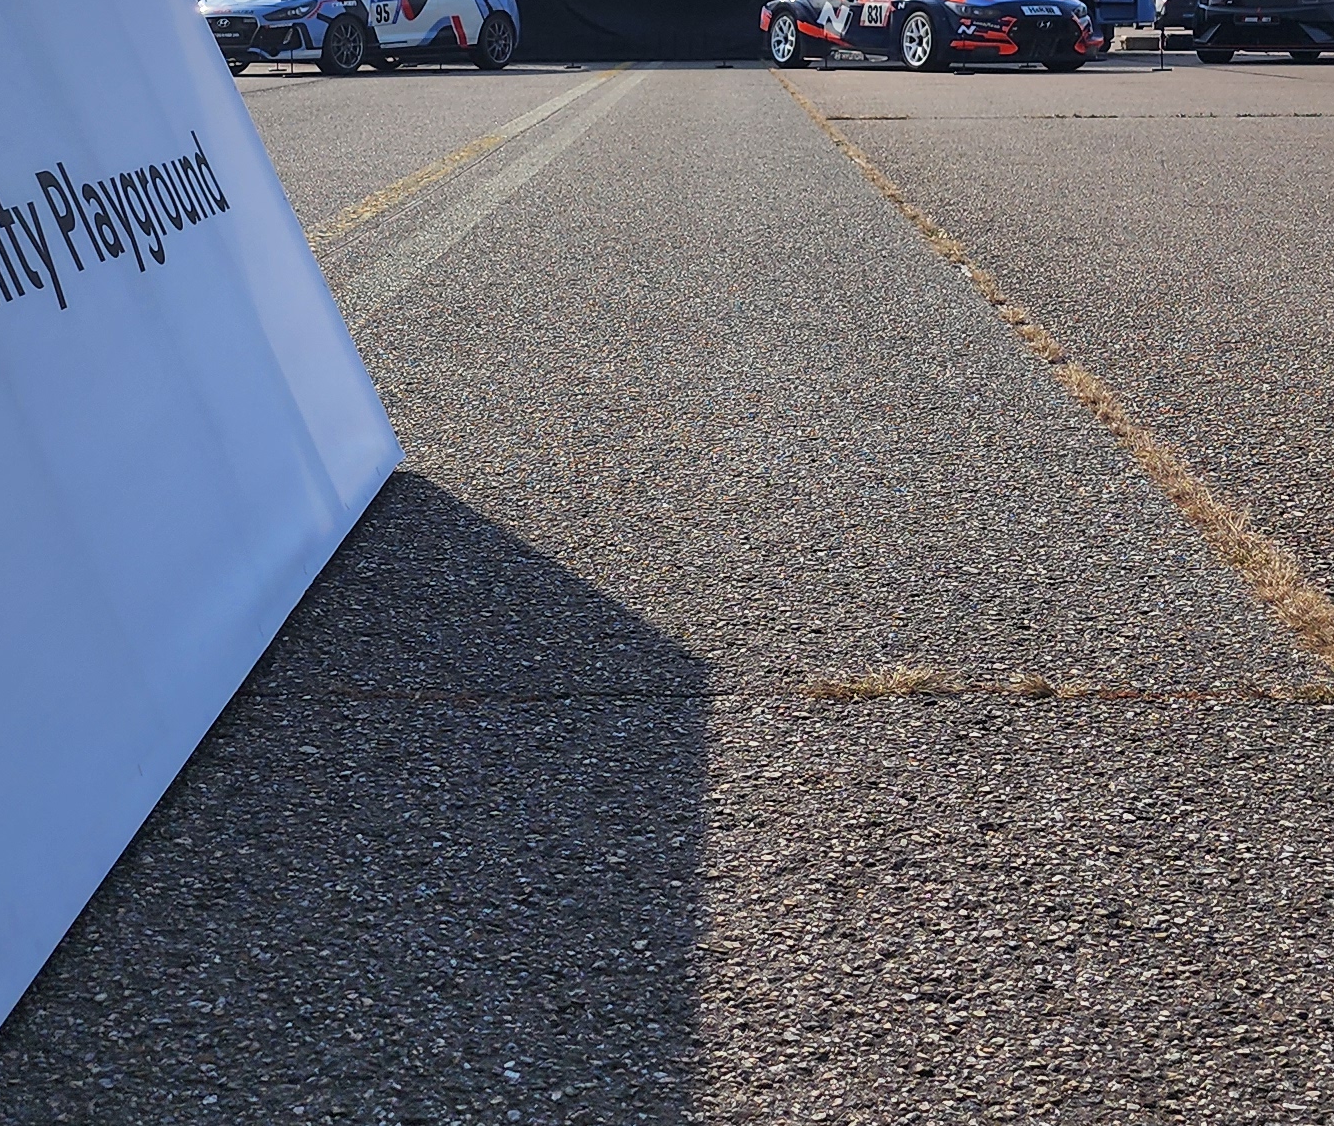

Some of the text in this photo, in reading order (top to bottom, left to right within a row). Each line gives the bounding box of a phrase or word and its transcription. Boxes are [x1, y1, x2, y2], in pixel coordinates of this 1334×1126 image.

[376, 3, 390, 23] 95
[867, 4, 883, 24] 831
[35, 131, 230, 274] Playground
